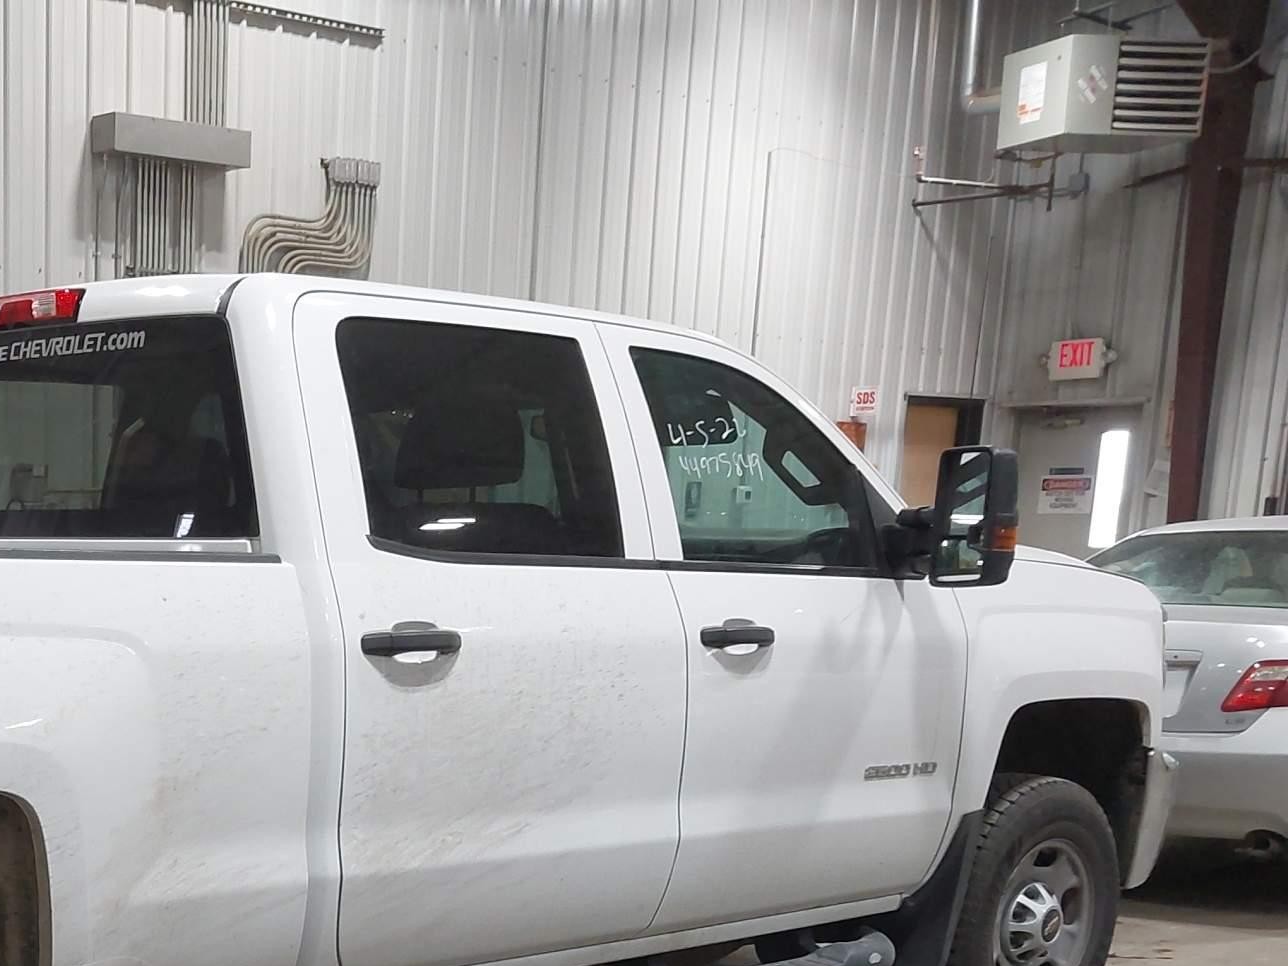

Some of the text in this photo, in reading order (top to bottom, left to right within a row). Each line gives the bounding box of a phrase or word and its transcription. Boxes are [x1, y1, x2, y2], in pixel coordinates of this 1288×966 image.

[1059, 342, 1095, 368] EXIT
[856, 391, 875, 404] SDS
[678, 452, 764, 481] 44975849
